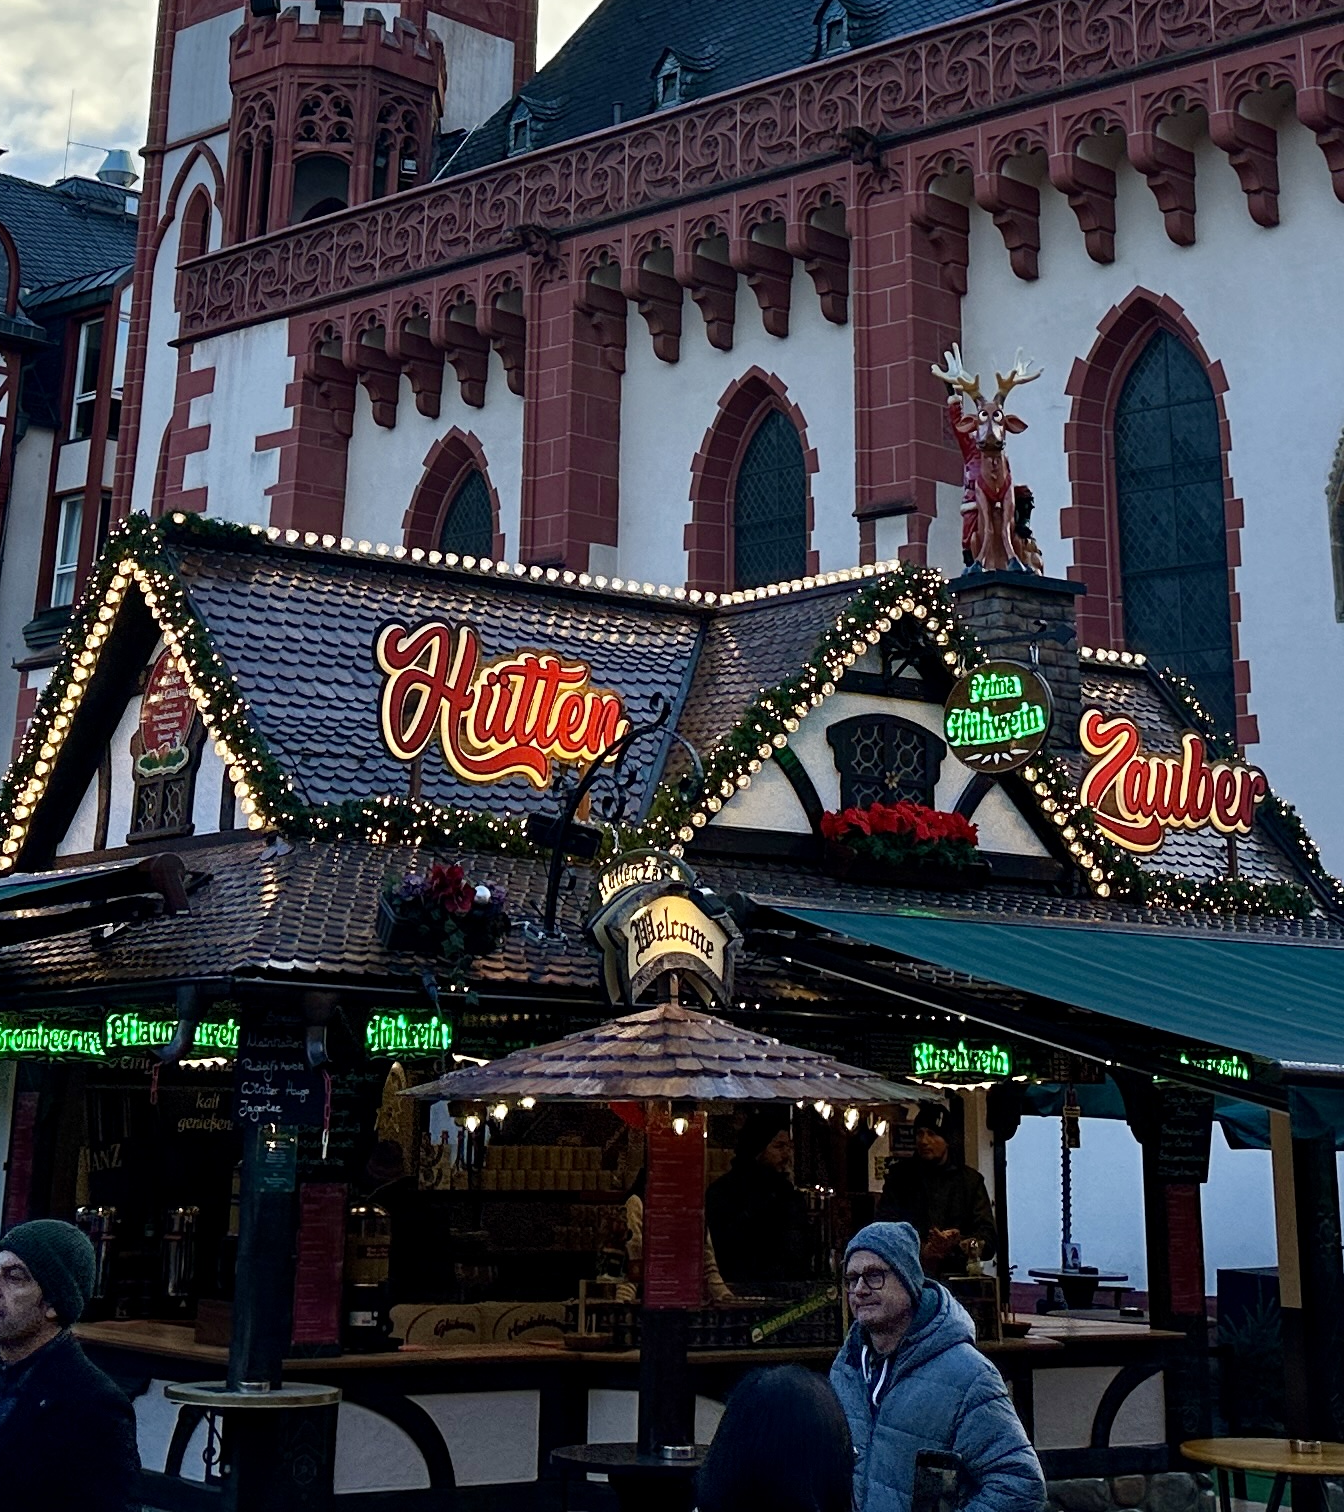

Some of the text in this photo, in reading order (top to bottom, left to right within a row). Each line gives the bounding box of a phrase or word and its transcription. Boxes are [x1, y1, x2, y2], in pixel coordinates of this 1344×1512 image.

[376, 623, 632, 788] Hütten
[969, 673, 1024, 704] Prima
[1079, 708, 1268, 853] Zauber
[629, 906, 714, 967] Welcome
[240, 1079, 311, 1104] Winter Hugo
